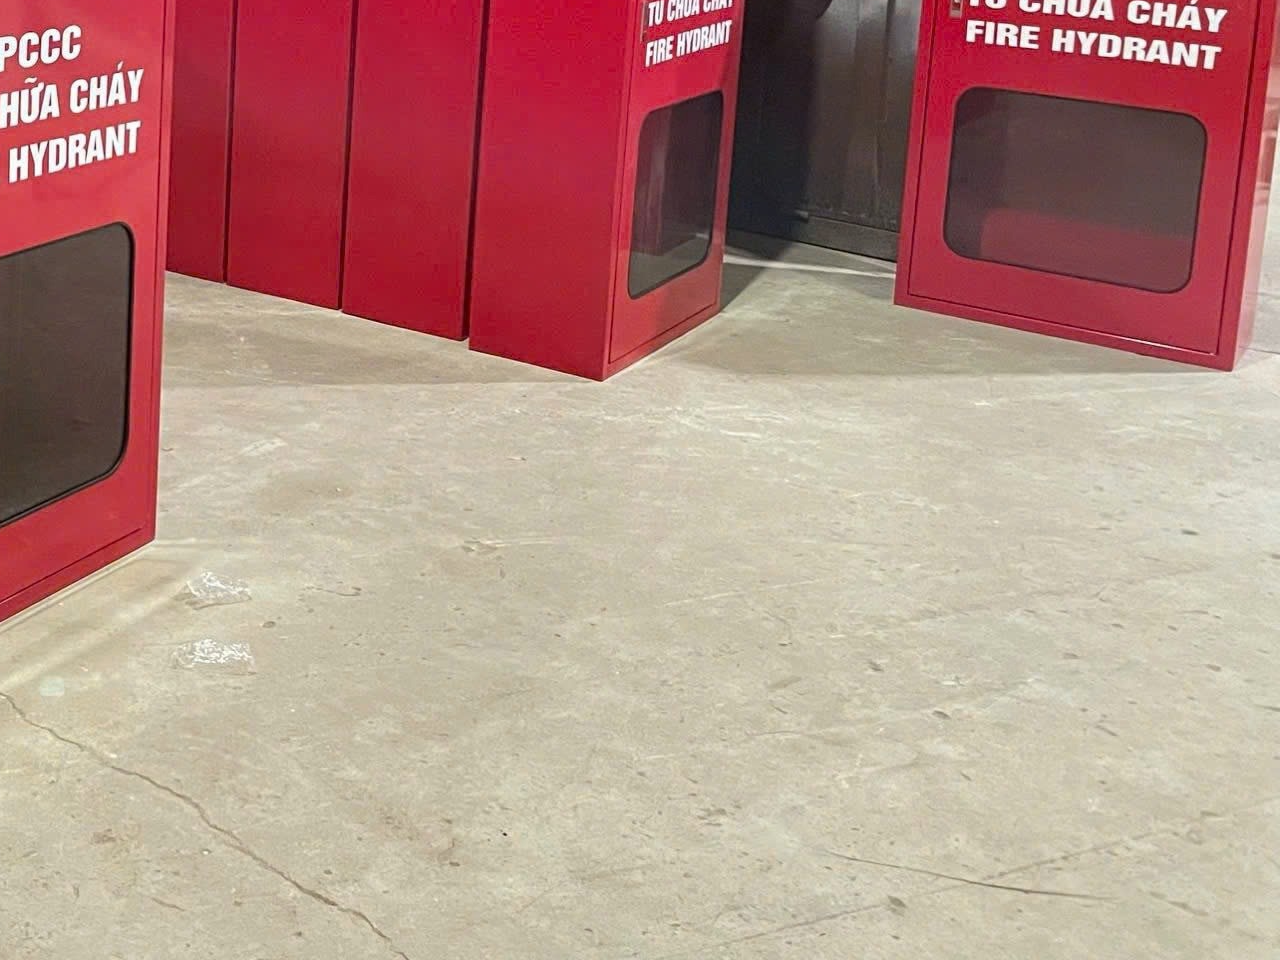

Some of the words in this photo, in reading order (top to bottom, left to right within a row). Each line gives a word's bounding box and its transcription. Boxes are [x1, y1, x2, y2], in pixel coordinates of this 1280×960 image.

[645, 35, 675, 68] FIRE
[676, 19, 733, 57] HYDRANT
[965, 19, 1041, 50] FIRE
[1051, 28, 1222, 70] HYDRANT
[69, 60, 145, 114] CHÁY
[8, 119, 142, 184] HYDRANT
